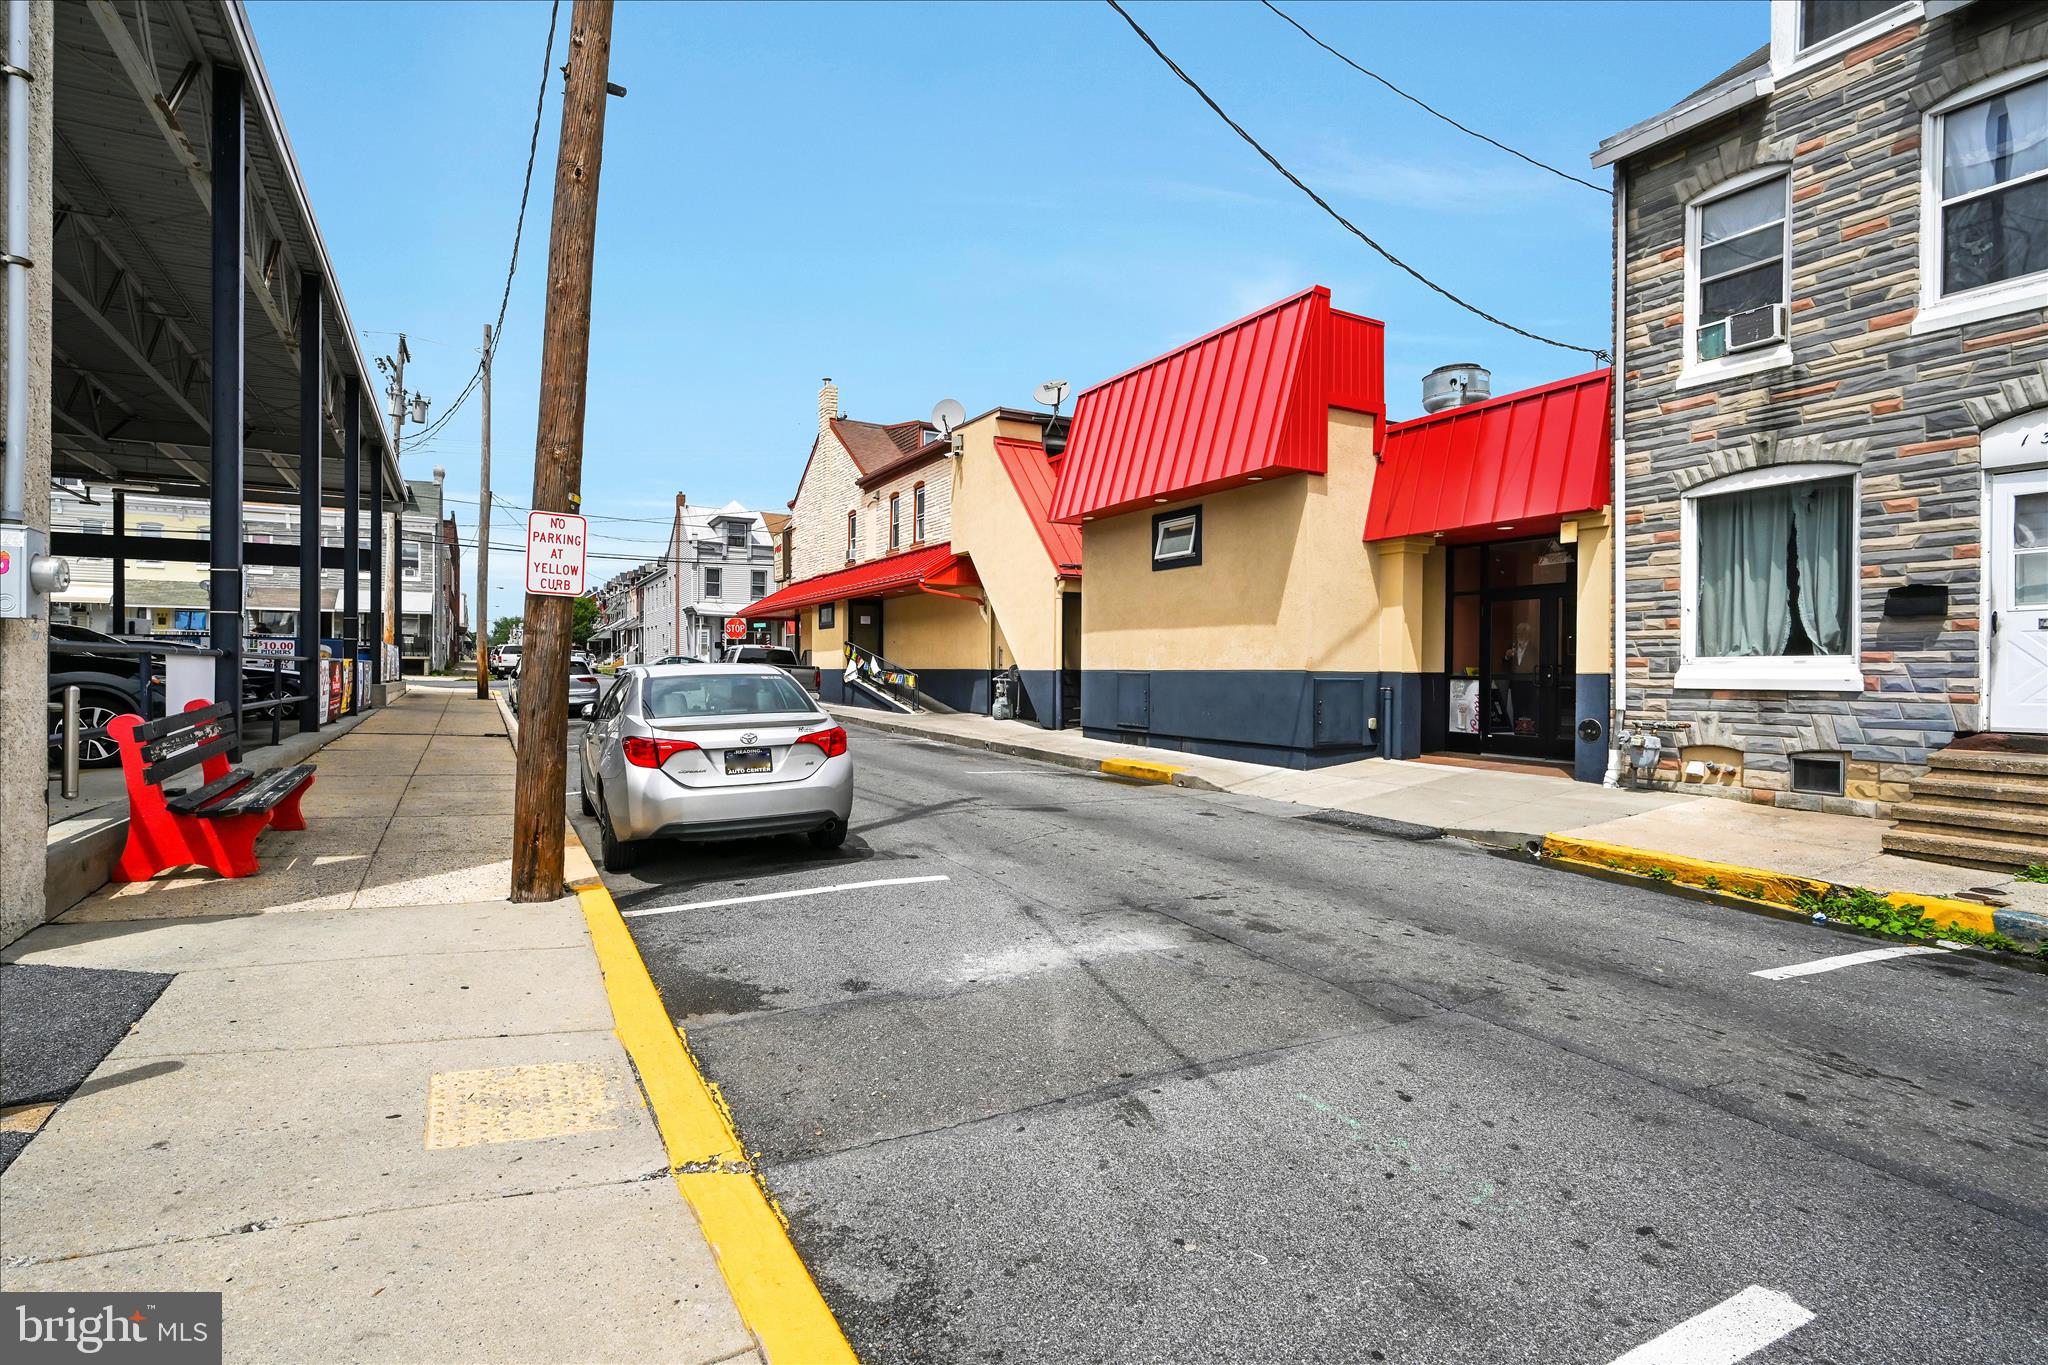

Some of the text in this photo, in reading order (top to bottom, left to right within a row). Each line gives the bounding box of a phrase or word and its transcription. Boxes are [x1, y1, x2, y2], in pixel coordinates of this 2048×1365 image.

[551, 518, 566, 529] NO
[533, 531, 581, 546] PARKING
[550, 548, 563, 559] AT
[534, 562, 579, 576] YELLOW
[540, 578, 571, 590] CURB
[726, 624, 745, 633] STOP
[258, 641, 294, 650] $10.00
